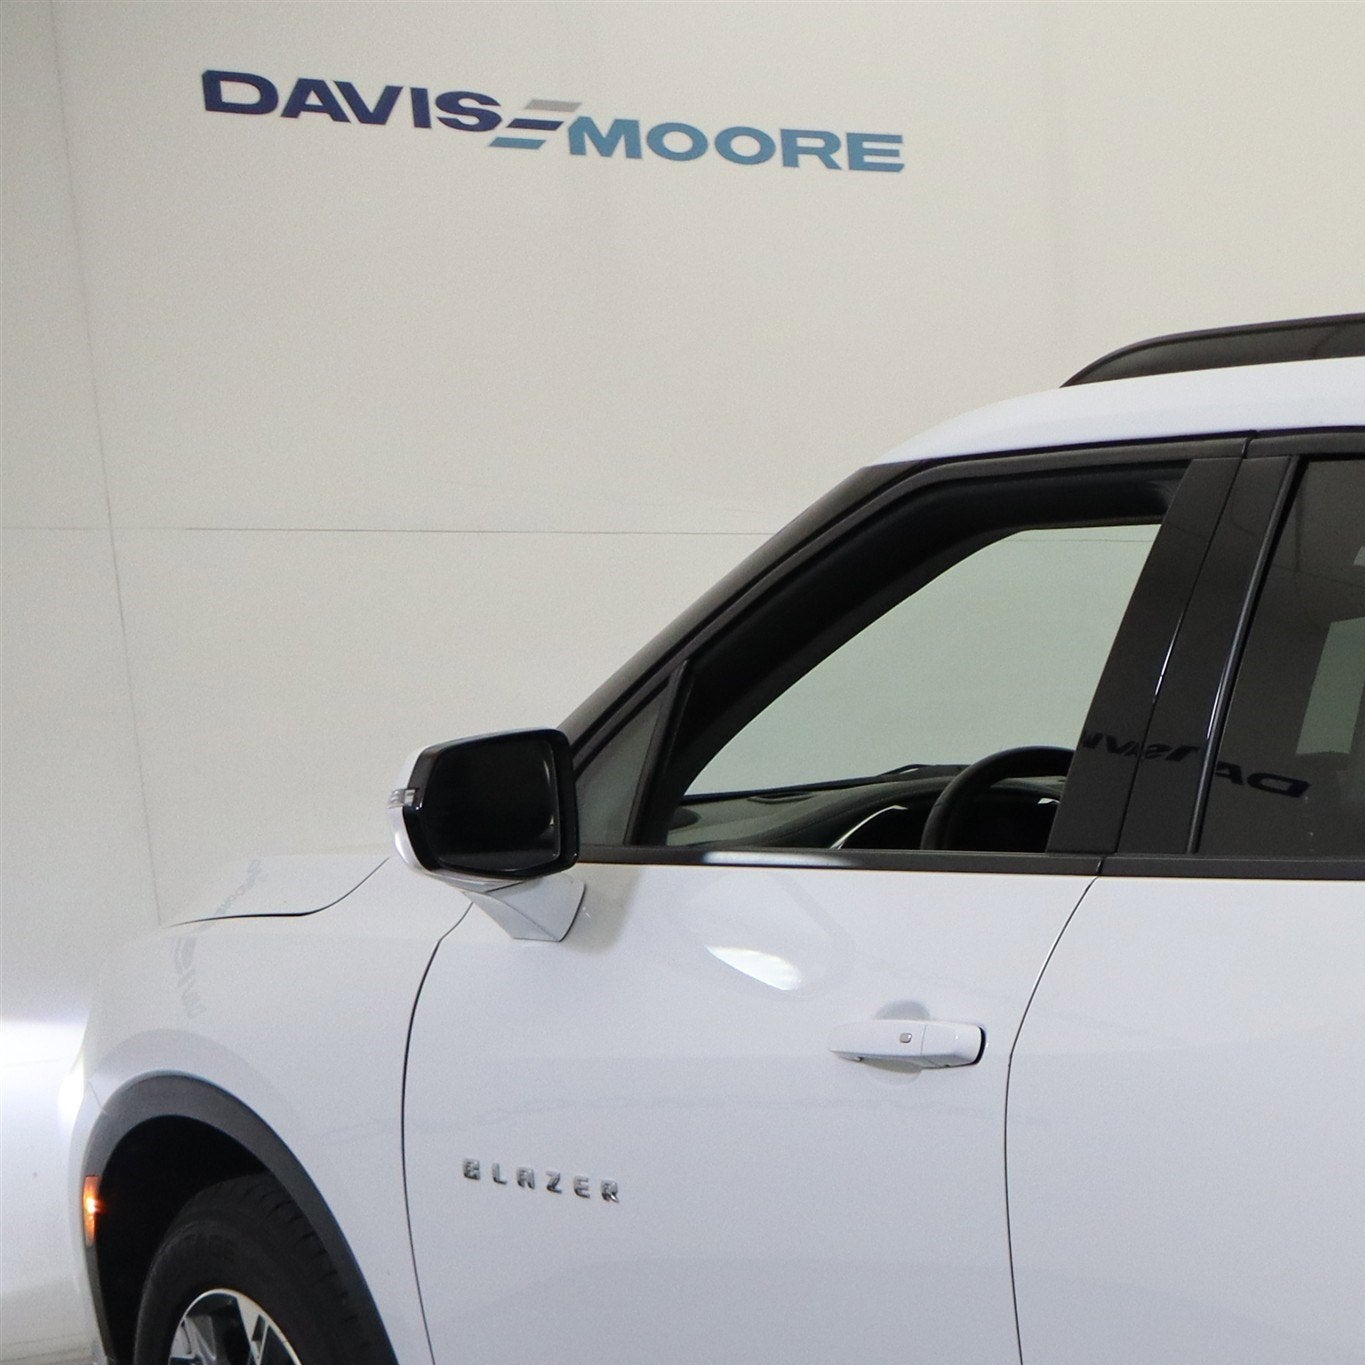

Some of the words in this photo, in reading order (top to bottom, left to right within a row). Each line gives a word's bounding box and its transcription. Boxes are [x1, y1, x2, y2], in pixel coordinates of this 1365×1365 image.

[201, 69, 502, 132] DAVIS
[567, 116, 905, 172] MOORE
[462, 1157, 619, 1203] BLAZER
